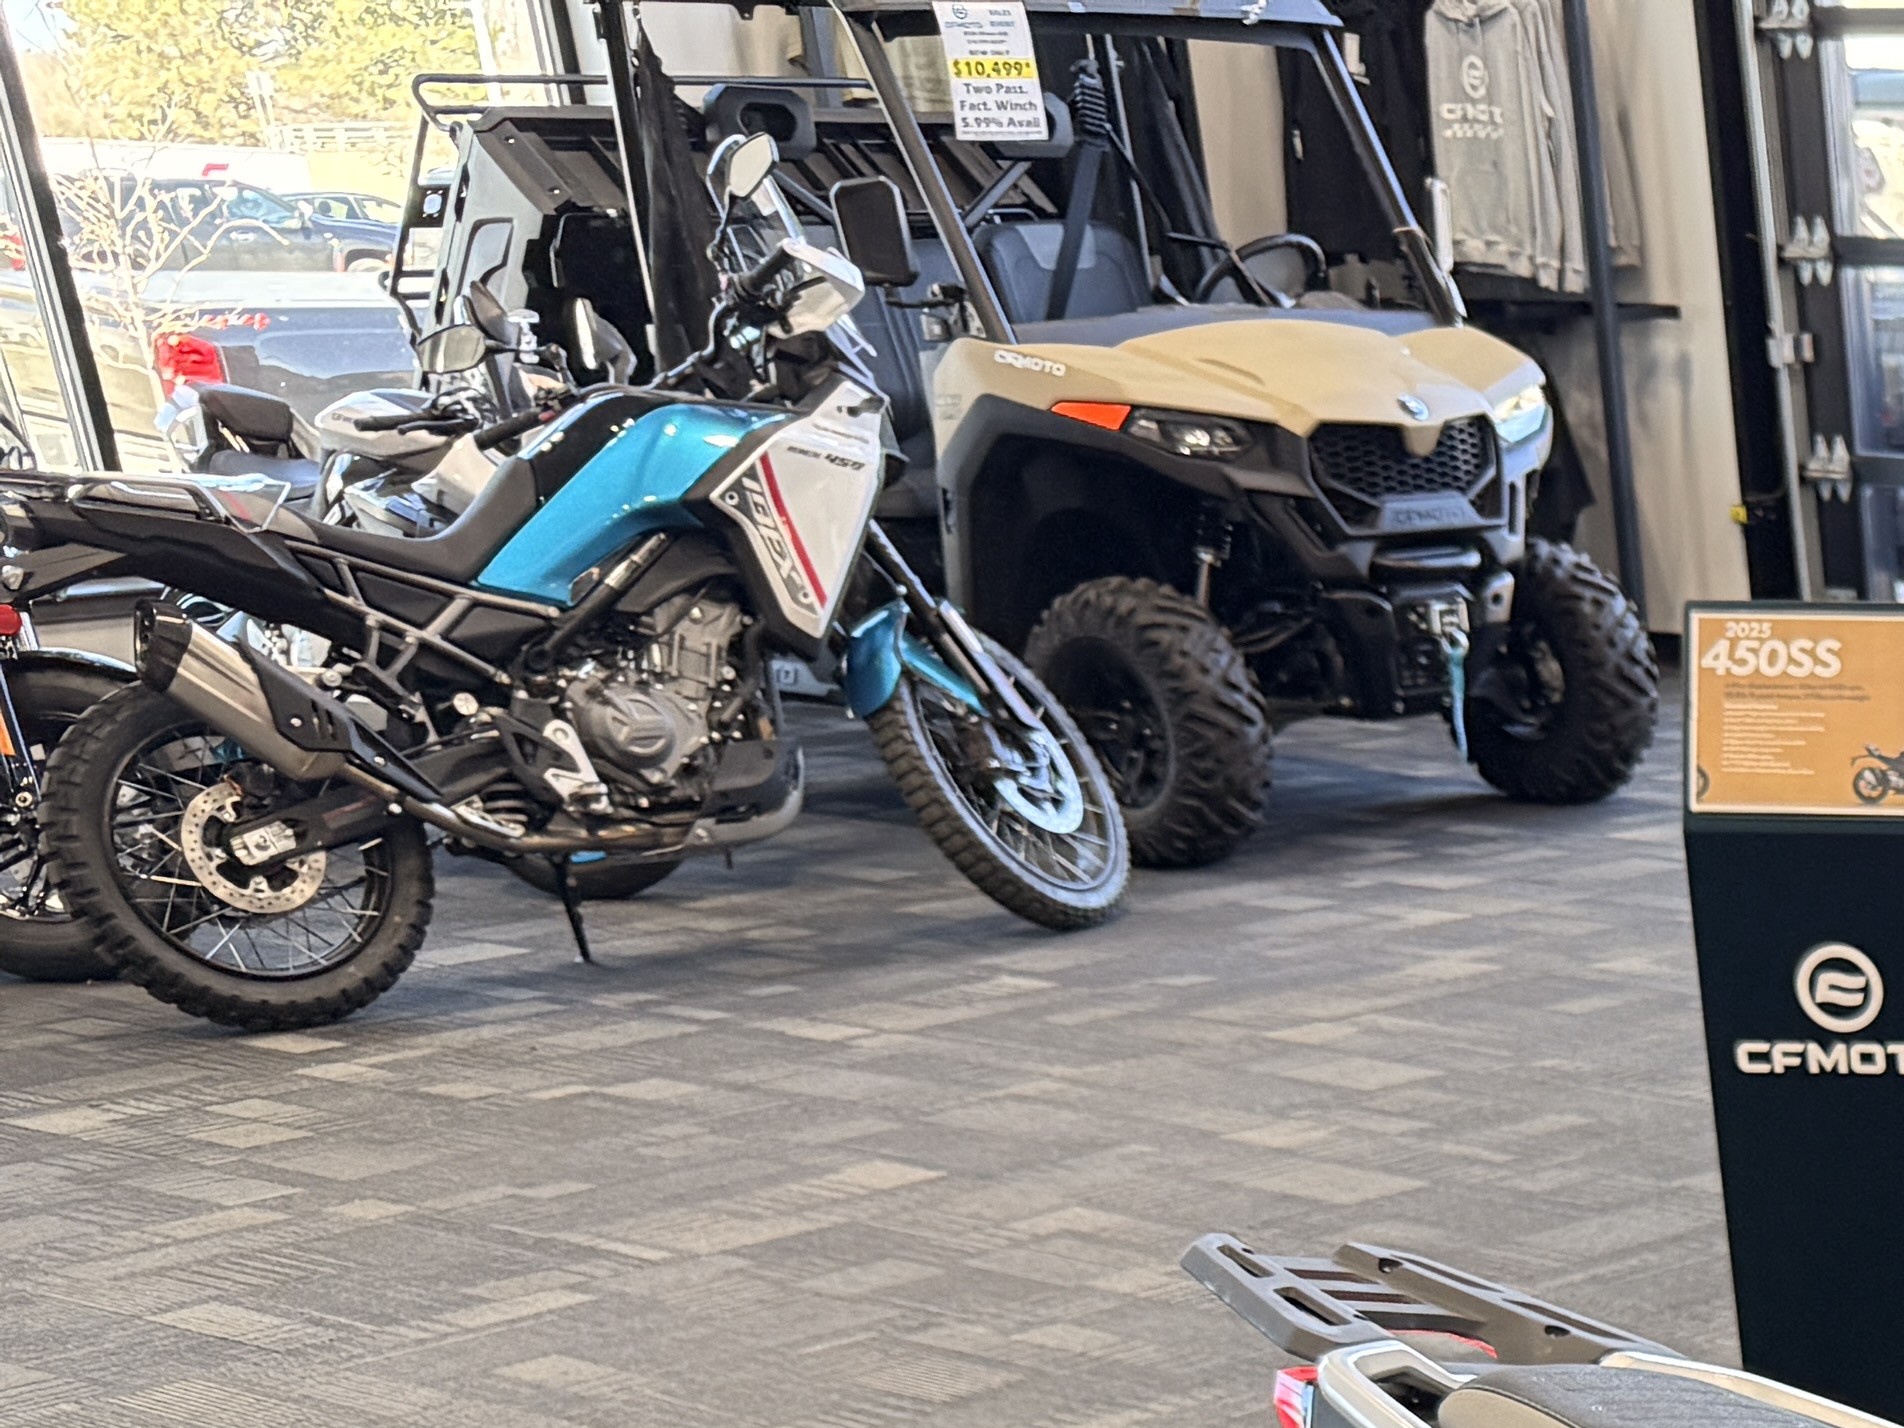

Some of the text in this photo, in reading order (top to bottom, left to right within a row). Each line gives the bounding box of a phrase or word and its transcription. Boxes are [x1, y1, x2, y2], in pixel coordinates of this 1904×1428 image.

[962, 83, 993, 95] Two
[995, 100, 1038, 112] Winch
[994, 348, 1067, 377] CFMOTO
[1722, 620, 1773, 639] 2025
[1700, 637, 1843, 678] 450SS
